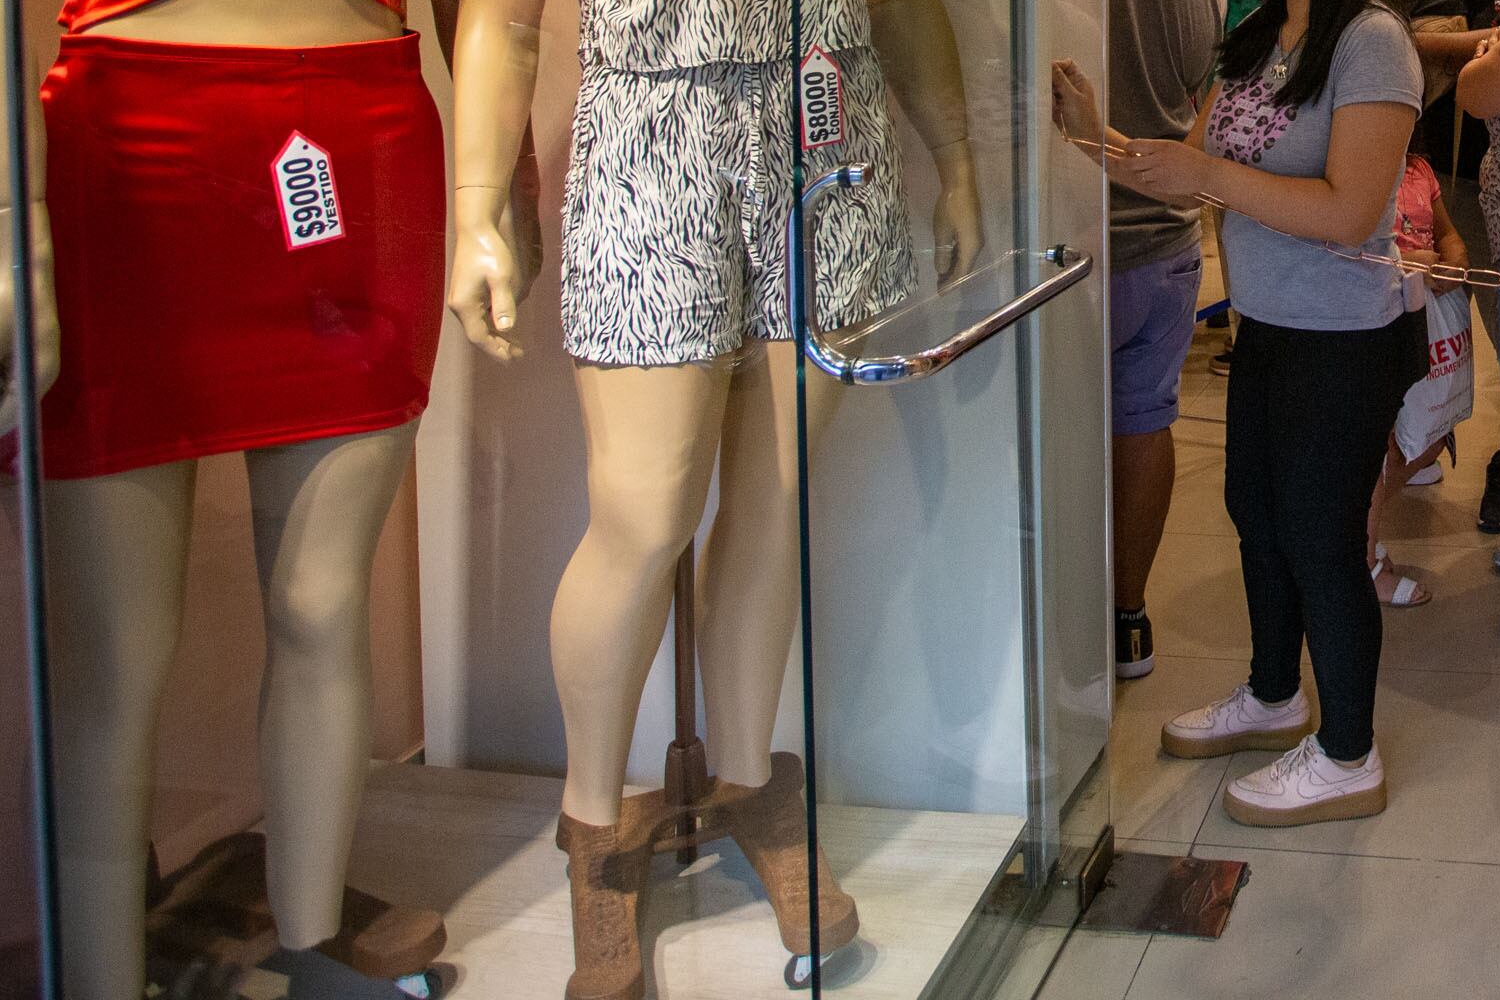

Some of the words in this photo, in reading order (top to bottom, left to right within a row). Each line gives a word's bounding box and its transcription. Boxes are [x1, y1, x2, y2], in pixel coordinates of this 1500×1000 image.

[803, 71, 829, 143] $8000
[826, 72, 840, 135] CONJUNTO
[283, 157, 329, 239] $9000
[316, 159, 338, 230] VESTIDO
